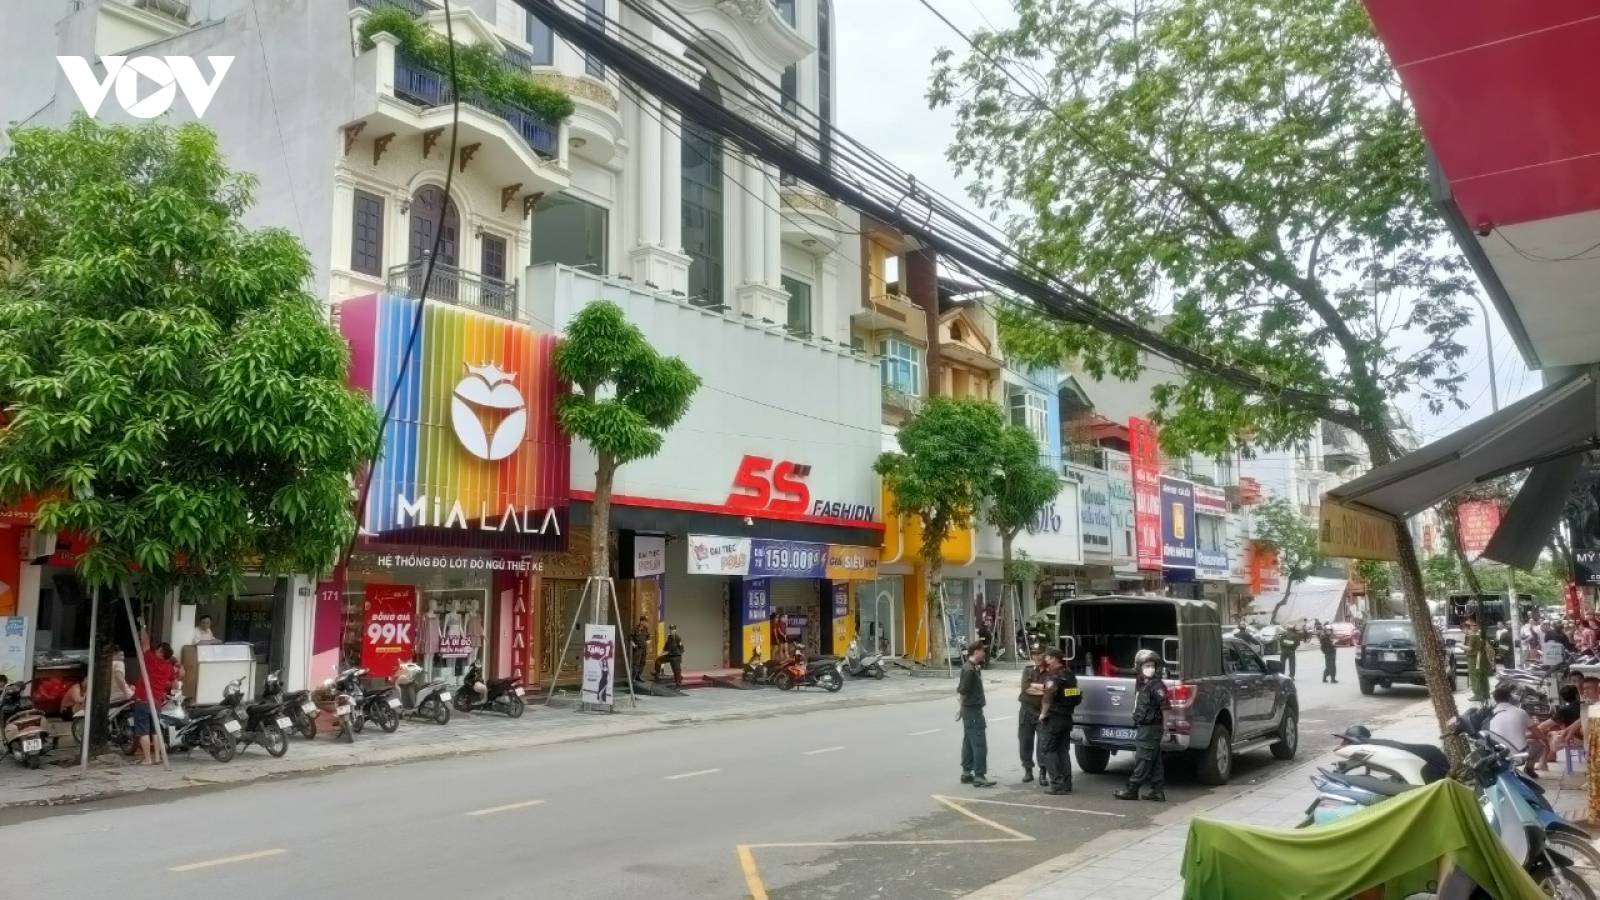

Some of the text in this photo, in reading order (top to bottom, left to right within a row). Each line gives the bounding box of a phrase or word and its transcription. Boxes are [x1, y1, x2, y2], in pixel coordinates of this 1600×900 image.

[725, 455, 875, 522] 5S FASHION
[481, 501, 561, 536] LALA
[378, 553, 392, 568] HỆ
[395, 552, 430, 567] THỐNG
[322, 590, 339, 601] 171
[367, 623, 411, 645] 99K
